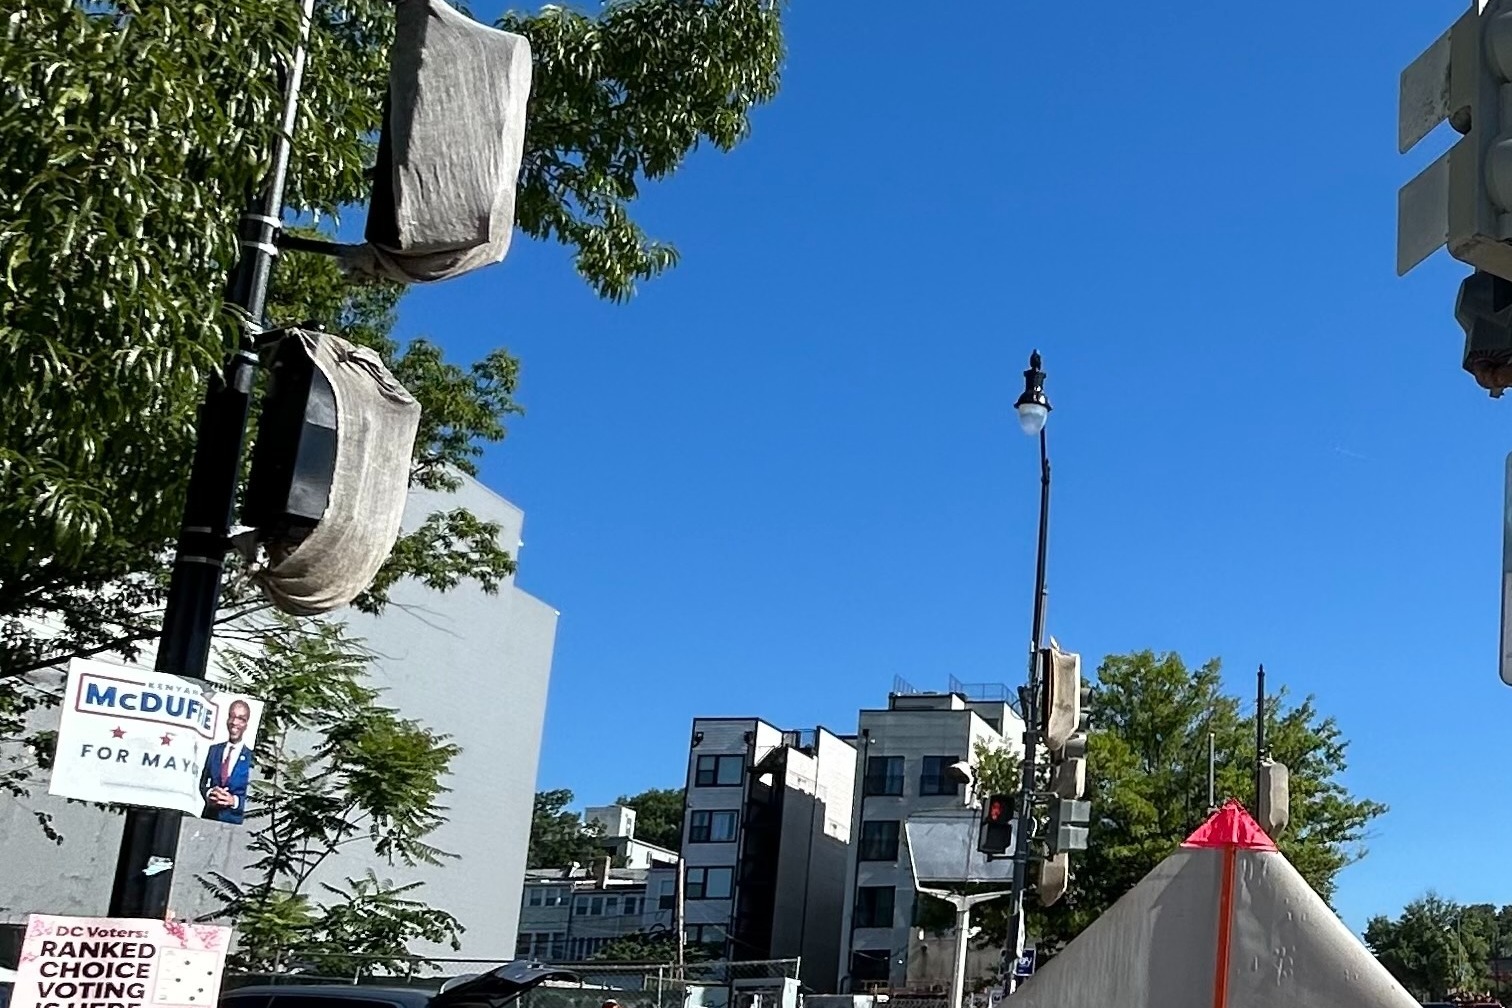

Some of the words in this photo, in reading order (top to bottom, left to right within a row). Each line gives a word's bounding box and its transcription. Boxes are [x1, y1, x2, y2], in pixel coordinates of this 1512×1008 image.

[80, 744, 129, 763] FOR
[55, 926, 84, 937] DC
[87, 927, 150, 939] Voters:
[40, 940, 157, 959] RANKED
[39, 961, 151, 979] CHOICE
[37, 982, 145, 999] VOTING
